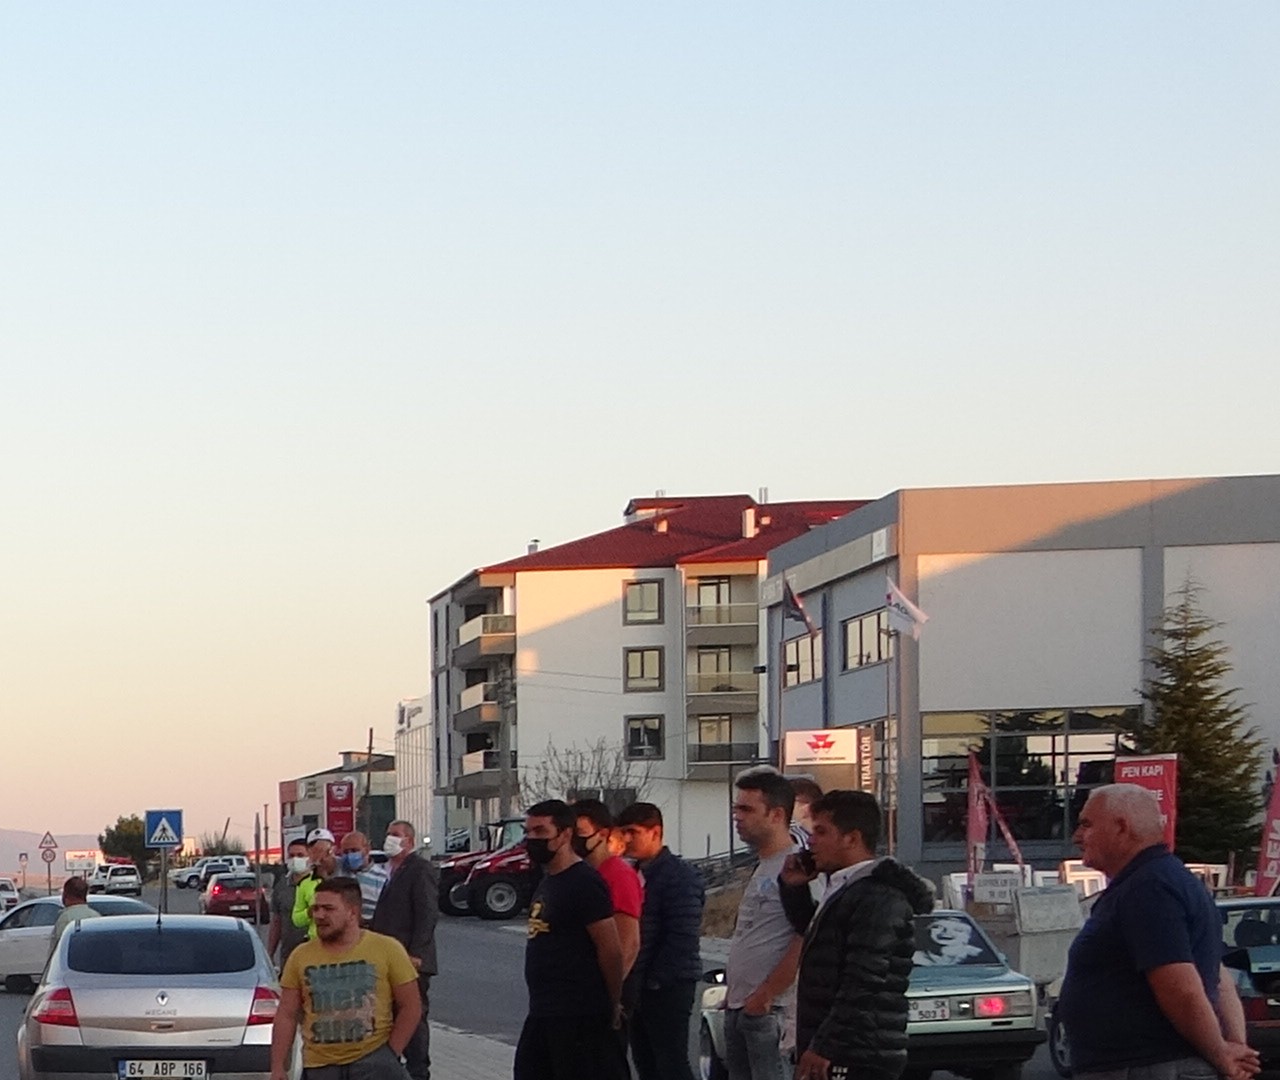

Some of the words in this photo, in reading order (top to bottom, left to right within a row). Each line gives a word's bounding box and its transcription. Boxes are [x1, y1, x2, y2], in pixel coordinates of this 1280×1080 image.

[861, 736, 872, 788] TRAKTÖR
[1121, 766, 1140, 777] PEN
[1141, 765, 1164, 776] KAPI
[129, 1062, 144, 1075] 64
[153, 1062, 176, 1075] ABP
[183, 1062, 203, 1075] 166
